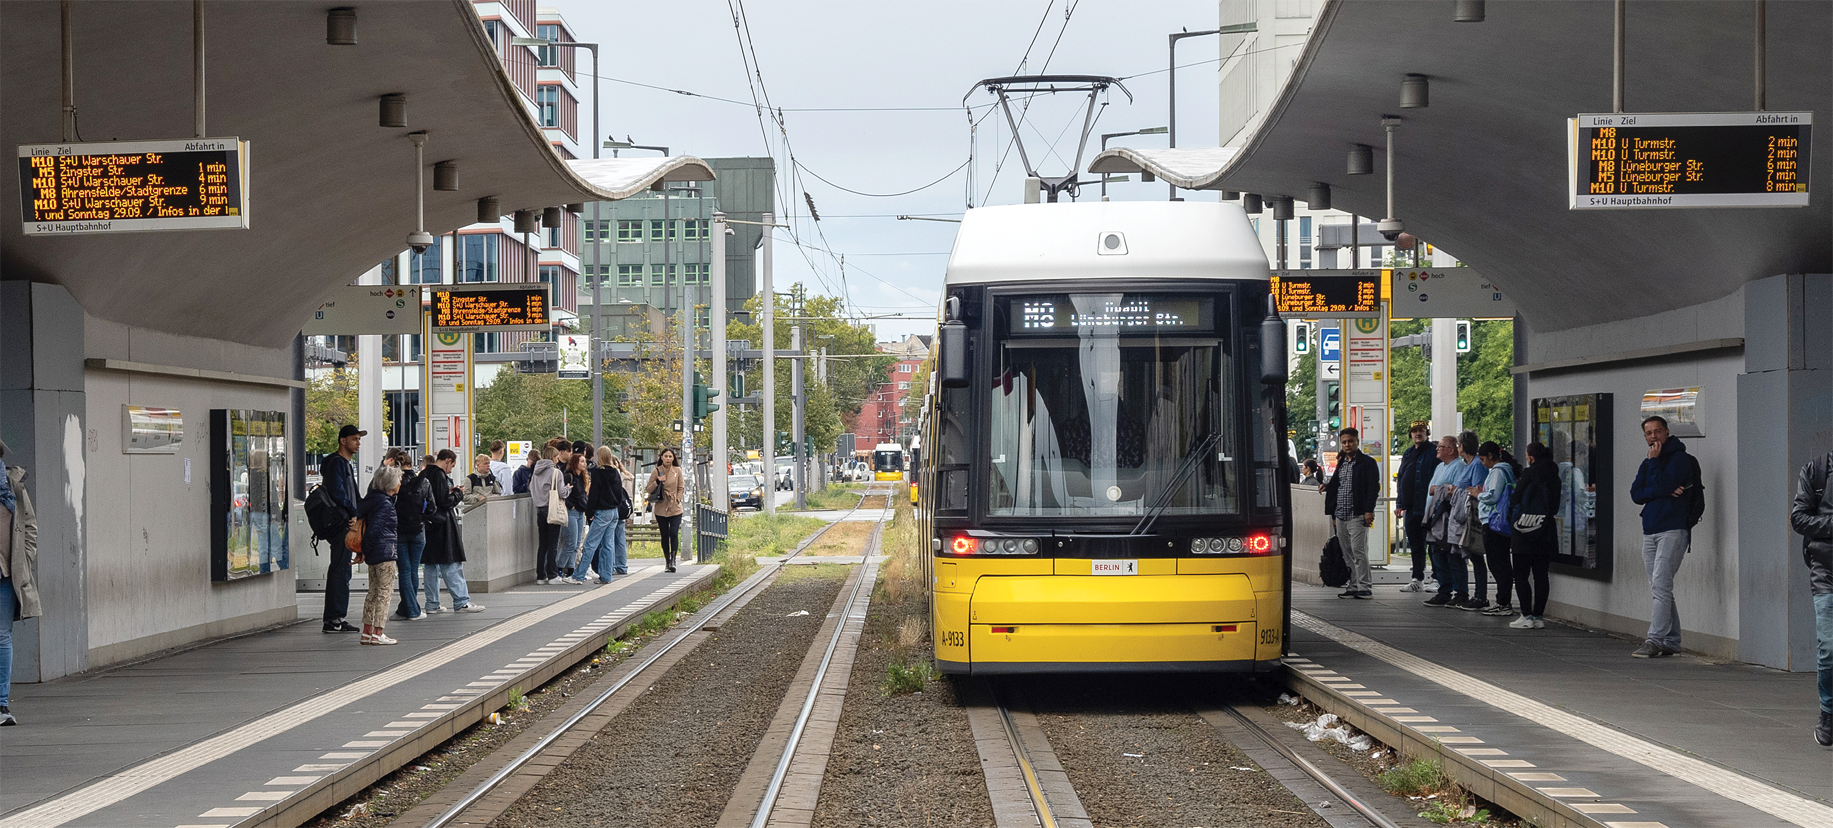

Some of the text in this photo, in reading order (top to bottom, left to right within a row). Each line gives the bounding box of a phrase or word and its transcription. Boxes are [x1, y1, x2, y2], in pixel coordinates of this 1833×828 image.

[1593, 117, 1613, 125] Linie
[1621, 117, 1636, 125] Ziel
[1756, 115, 1788, 123] Abfahrt
[1600, 127, 1616, 138] M8
[1592, 136, 1798, 149] M10 U Turmstr. 2 min
[1592, 147, 1797, 160] M10 U Turmstr. 2 min
[32, 153, 164, 168] M10 S+U Warschauer Str.
[1598, 159, 1797, 172] M8 Lüneburger Str. 6 min
[39, 162, 226, 178] M5 Zingster Str. 1 min
[1598, 170, 1796, 182] M5 Lüneburger Str. 7 min
[32, 172, 226, 188] M10 S+U Warschauer Str. 4 min
[1590, 180, 1795, 193] M10 U Turmstr. 8 min
[40, 183, 227, 199] M8 Ahrensfelde/Stadtgrenze 6 min
[34, 194, 228, 210] M10 S+U Warschauer Str. 9 min
[1611, 196, 1672, 207] Hauptbahnhof
[45, 210, 64, 220] und
[68, 208, 110, 220] Sonntag
[114, 207, 142, 218] 29.09.
[158, 206, 184, 217] Infos
[189, 205, 199, 216] in
[204, 205, 221, 216] der
[37, 222, 111, 233] S+U Hauptbahnhof
[1024, 302, 1054, 328] M8
[1518, 513, 1546, 526] NIKE
[942, 630, 964, 647] A-9133
[1261, 629, 1280, 644] 9133-A
